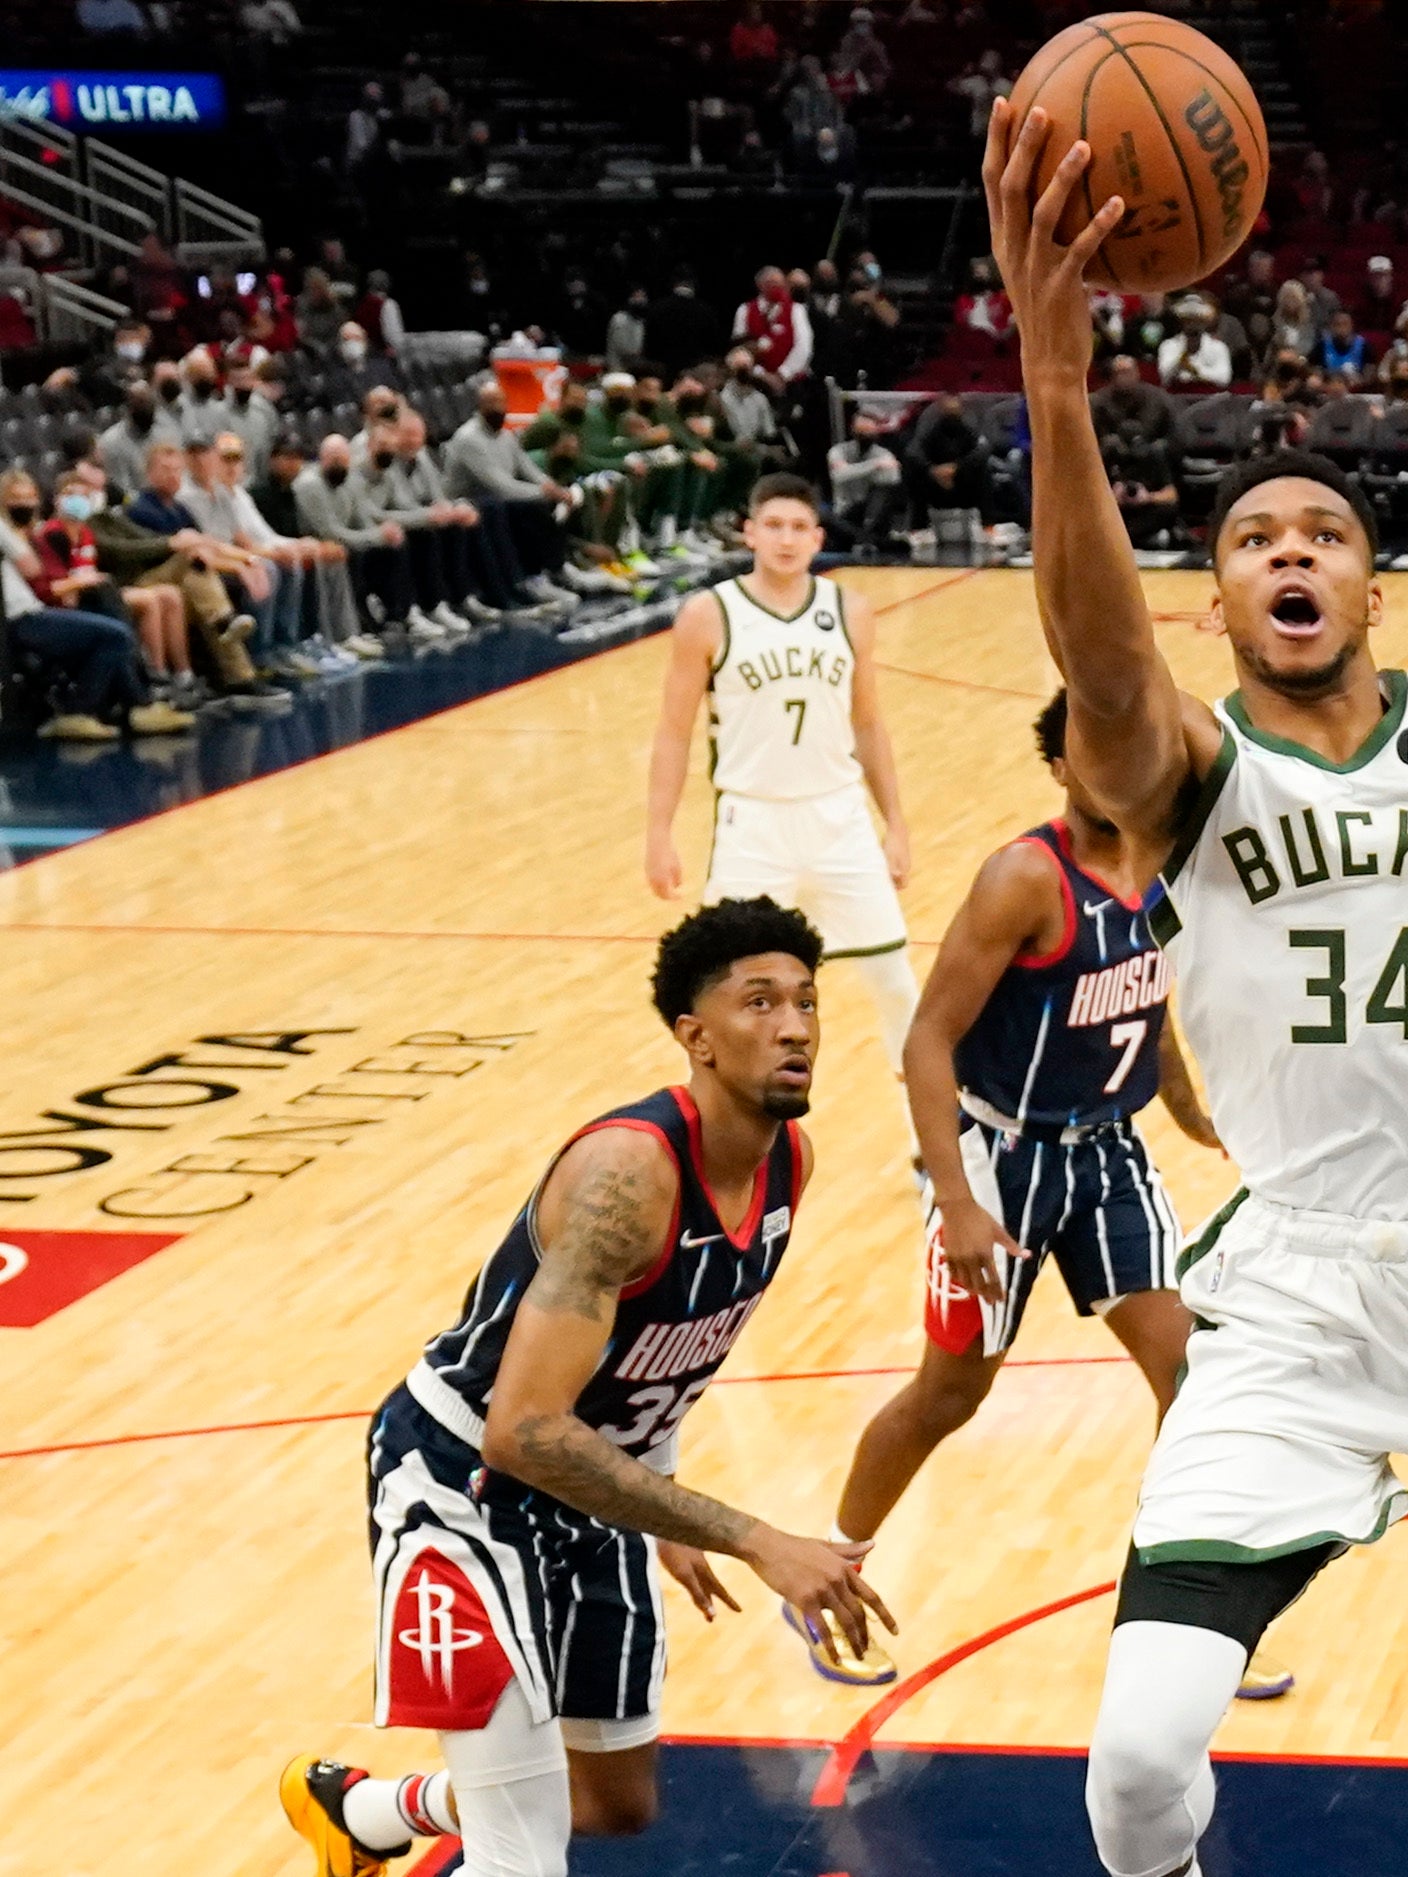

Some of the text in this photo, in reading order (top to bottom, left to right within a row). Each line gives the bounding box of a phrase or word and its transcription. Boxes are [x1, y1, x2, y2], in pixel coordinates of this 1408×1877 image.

[77, 84, 199, 122] ULTRA
[738, 647, 846, 691] BUCKS
[785, 699, 806, 745] 7
[1104, 1020, 1147, 1095] 7
[0, 1027, 362, 1203] OYOTA
[100, 1030, 538, 1218] CENTER
[598, 1373, 714, 1448] 35
